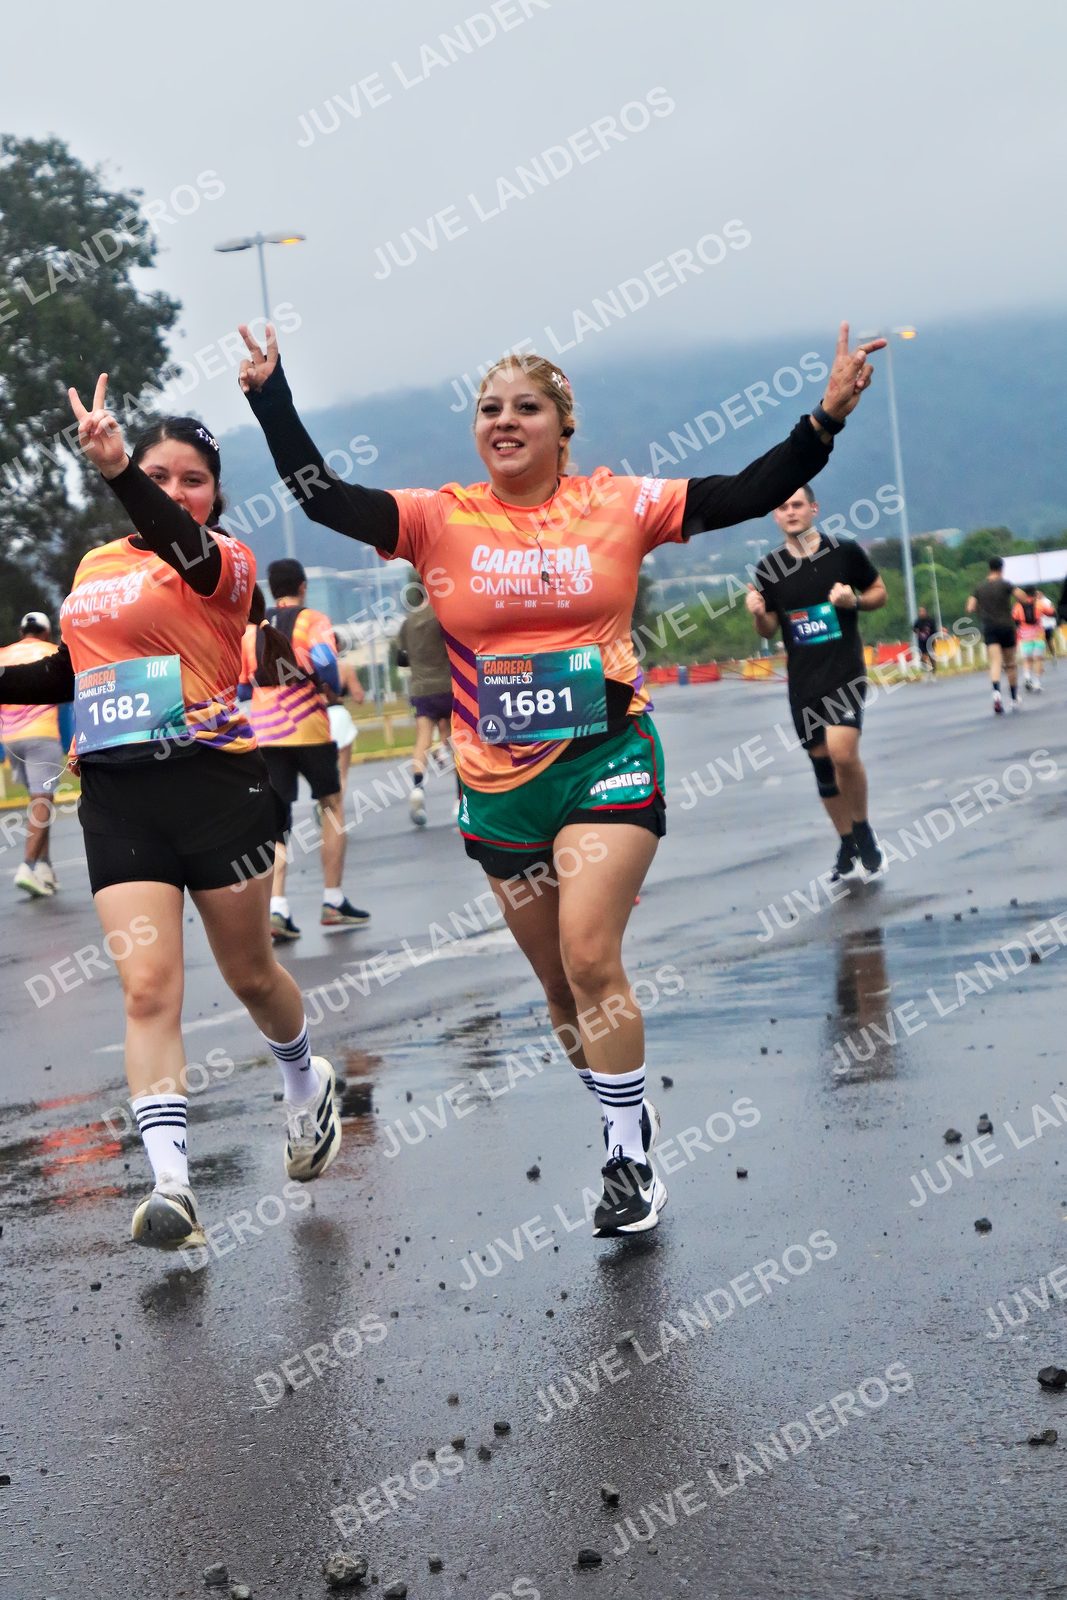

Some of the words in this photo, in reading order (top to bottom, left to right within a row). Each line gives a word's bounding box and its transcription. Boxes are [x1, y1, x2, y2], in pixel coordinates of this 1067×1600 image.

[471, 544, 592, 575] CARRERA
[797, 620, 828, 636] 1304
[146, 661, 169, 679] 10K
[483, 659, 533, 675] CARRERA
[569, 652, 592, 672] 10K
[78, 668, 117, 690] CARRERA
[88, 692, 151, 726] 1682
[499, 687, 573, 716] 1681
